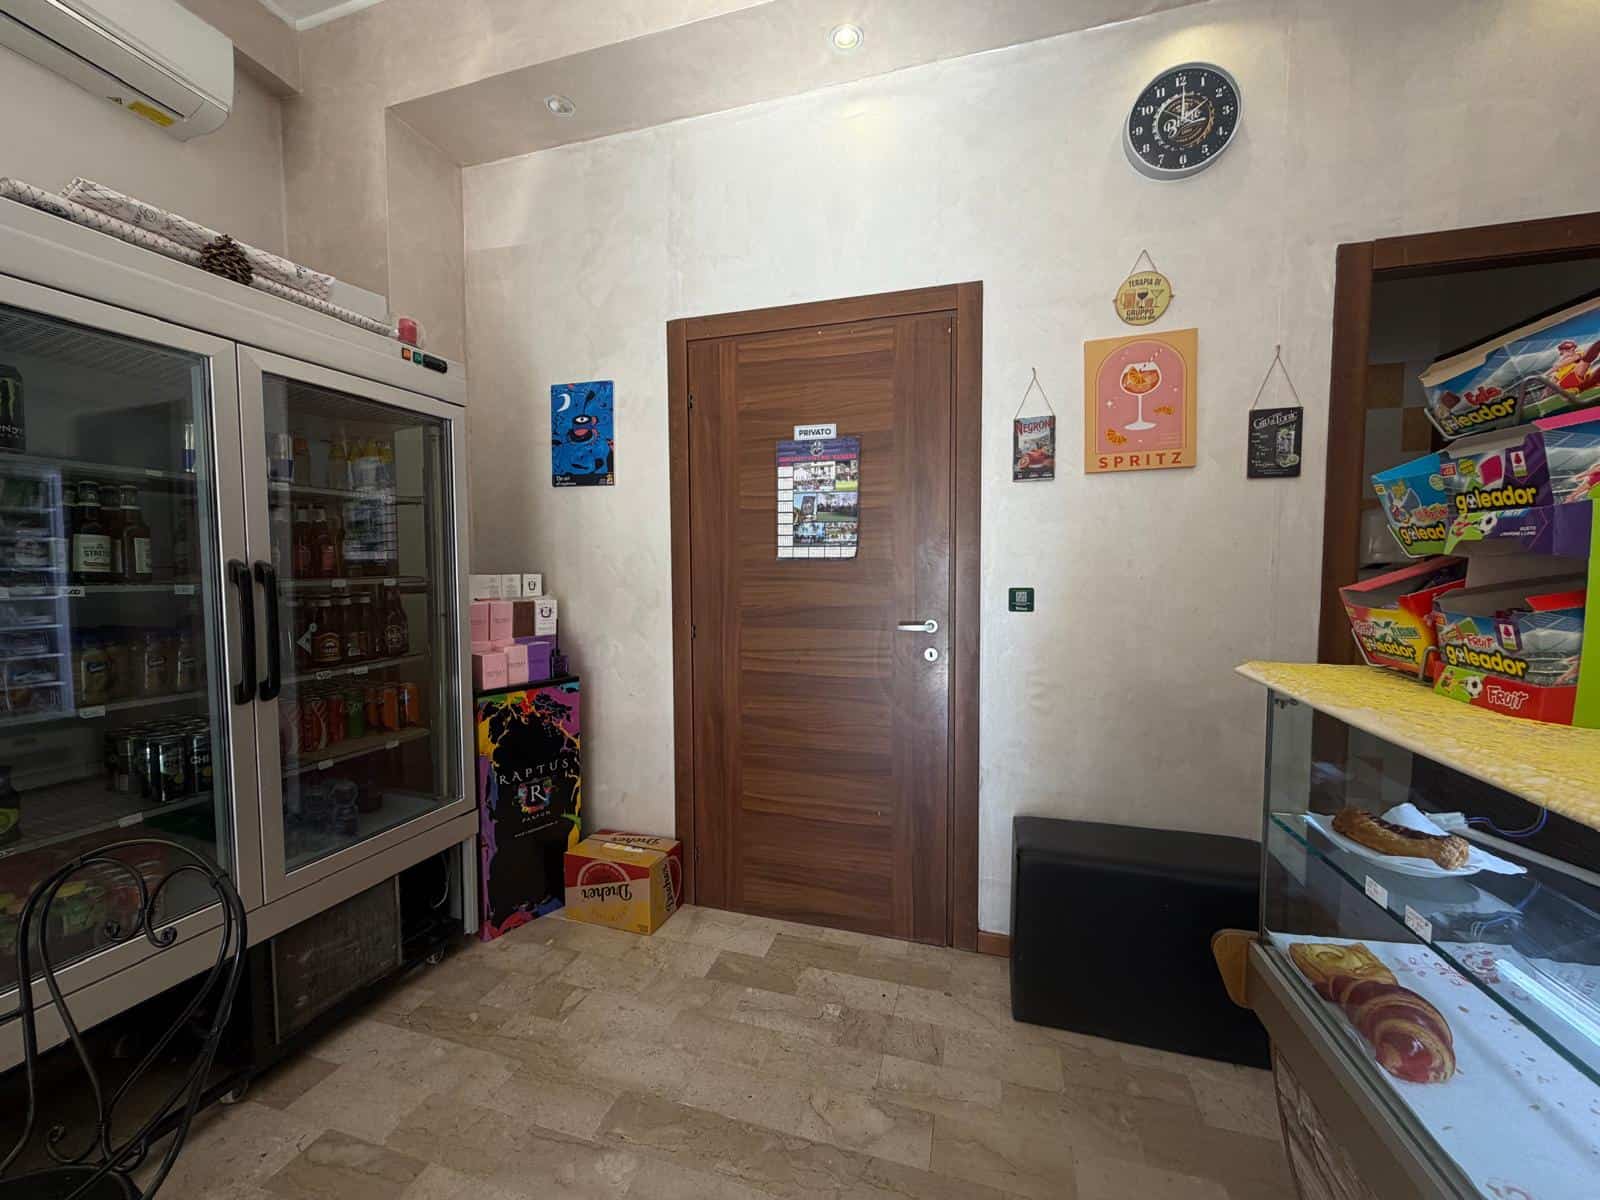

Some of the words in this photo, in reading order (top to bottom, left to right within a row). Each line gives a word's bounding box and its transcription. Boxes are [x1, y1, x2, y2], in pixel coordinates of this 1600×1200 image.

[1175, 76, 1188, 87] 12
[1200, 76, 1206, 87] 1
[1156, 87, 1166, 98] 11
[1215, 87, 1223, 98] 2
[1141, 105, 1154, 116] 10
[1222, 105, 1230, 115] 3
[1135, 126, 1143, 135] 9
[1143, 143, 1150, 153] 8
[1202, 144, 1209, 154] 5
[1158, 154, 1165, 164] 7
[1179, 154, 1187, 164] 6
[1126, 308, 1155, 316] GRUPPO
[798, 428, 832, 436] PRIVATO
[1099, 451, 1183, 469] SPRITZ
[1455, 486, 1537, 516] goleador
[1446, 645, 1527, 677] goleador
[499, 758, 569, 785] RAPTUS
[531, 784, 547, 802] R
[611, 837, 661, 847] Dreher
[581, 884, 632, 903] Dreher
